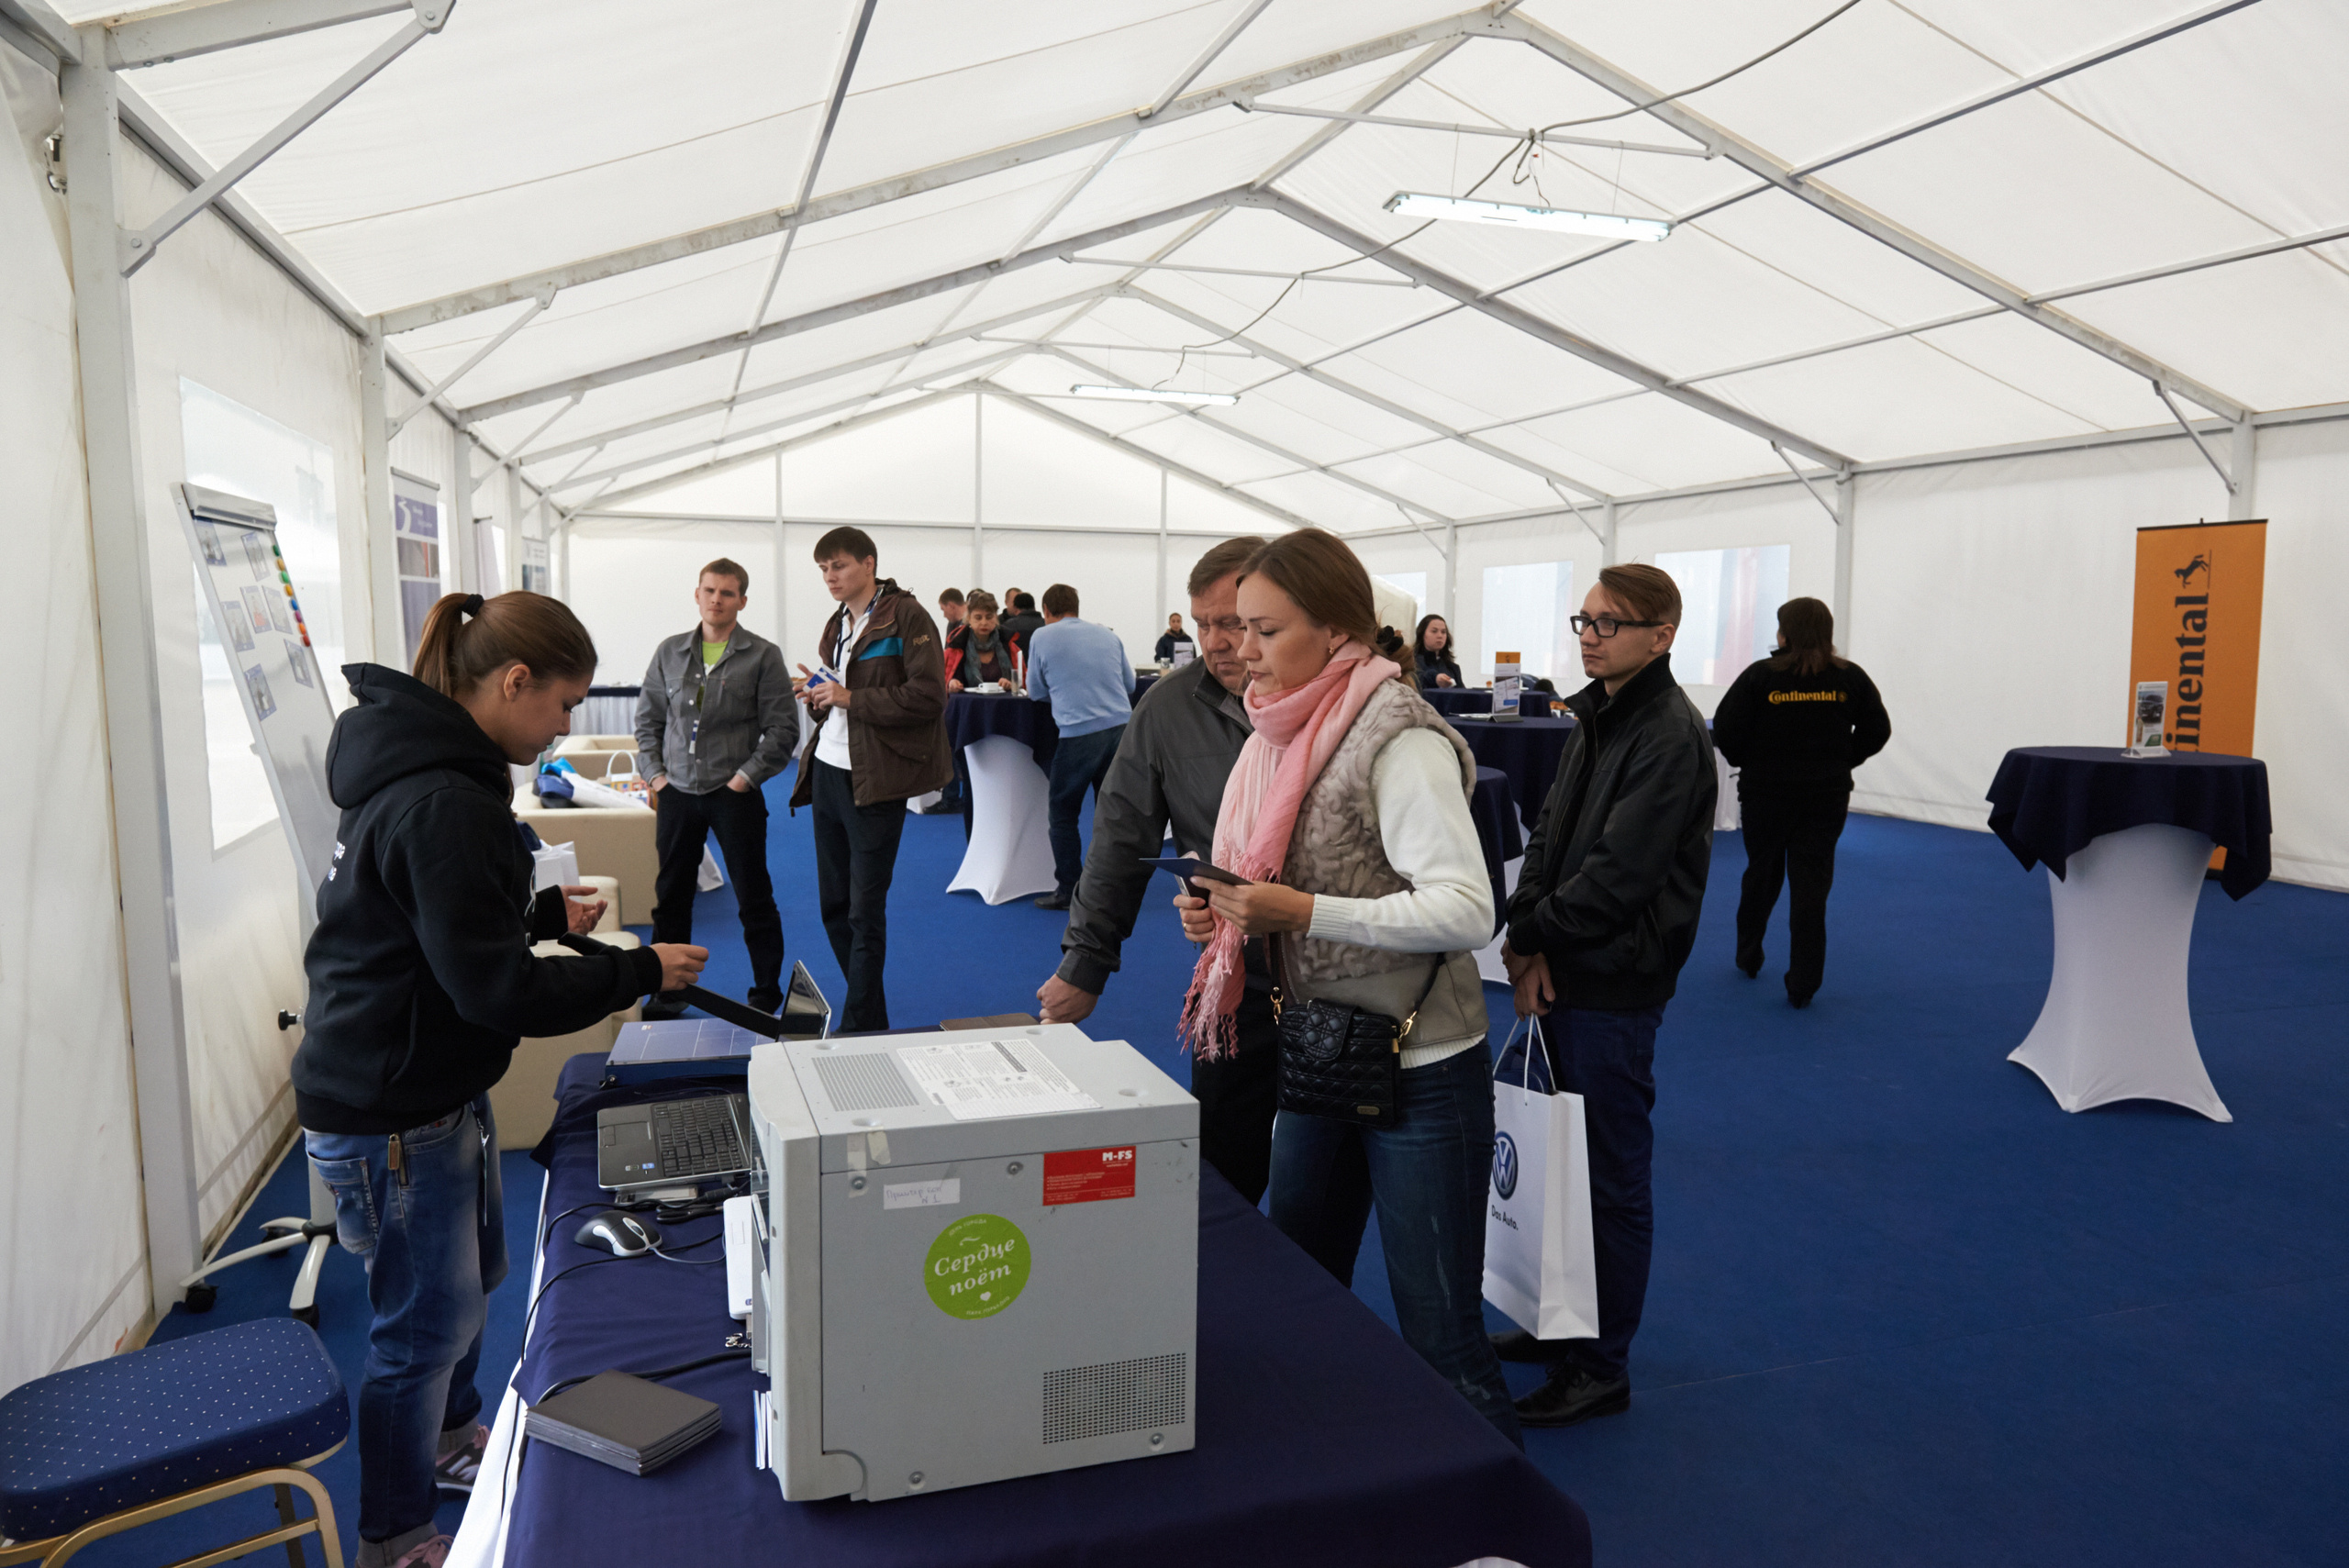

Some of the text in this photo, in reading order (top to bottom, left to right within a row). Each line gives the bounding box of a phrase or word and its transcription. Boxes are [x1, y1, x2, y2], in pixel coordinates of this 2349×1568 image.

[2165, 593, 2209, 751] inental
[1768, 690, 1837, 705] Continental
[1102, 1150, 1133, 1162] M-FS
[1491, 1204, 1519, 1231] Das Auto.
[934, 1239, 1016, 1276] Сердце
[949, 1264, 1011, 1296] поёт
